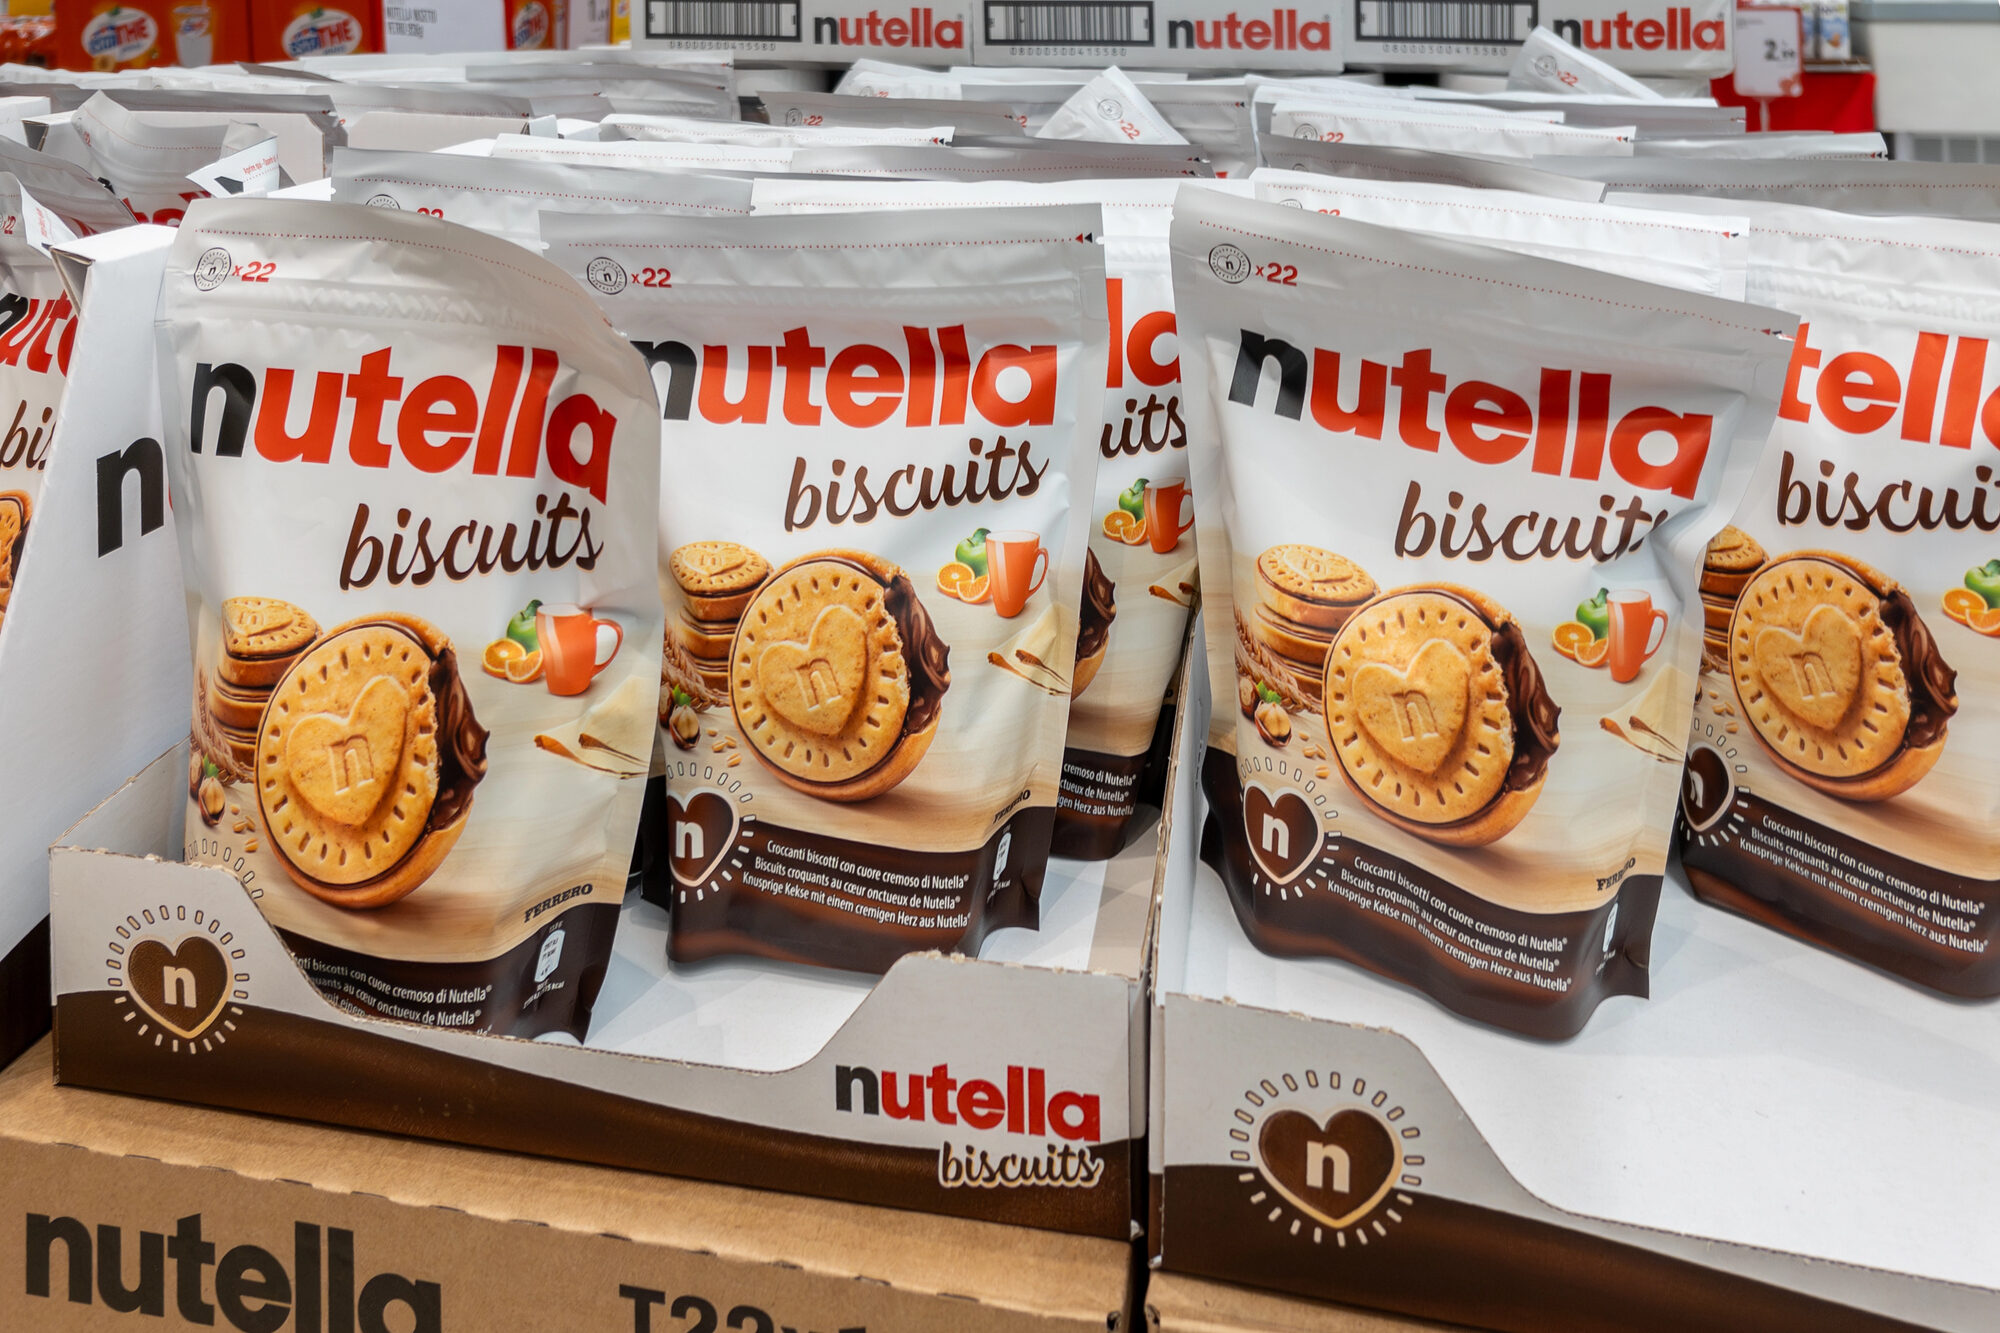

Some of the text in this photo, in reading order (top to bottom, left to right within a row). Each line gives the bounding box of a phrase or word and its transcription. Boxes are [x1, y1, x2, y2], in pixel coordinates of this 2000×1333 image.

[232, 260, 277, 283] x22
[631, 267, 673, 289] x22
[1255, 261, 1298, 287] x22
[630, 323, 1057, 428] nutella
[191, 344, 618, 505] nutella
[1228, 328, 1713, 500] nutella
[784, 435, 1049, 532] biscuits
[340, 492, 605, 592] biscuits
[1085, 785, 1095, 798] de
[1092, 805, 1106, 815] aus
[675, 820, 704, 859] n
[1262, 813, 1289, 860] n
[1762, 815, 1803, 842] Croccanti
[1804, 832, 1838, 859] biscotti
[1839, 852, 1856, 868] con
[1858, 862, 1884, 881] cuore
[1886, 875, 1927, 900] cremoso
[1929, 890, 1939, 904] di
[755, 856, 786, 876] Biscuits
[787, 867, 829, 887] croquants
[830, 877, 842, 890] au
[867, 888, 908, 907] onctueux
[909, 894, 921, 908] de
[767, 840, 806, 860] Croccanti
[807, 848, 839, 869] biscotti
[840, 861, 855, 874] con
[856, 865, 881, 880] cuore
[882, 871, 920, 888] cremoso
[921, 875, 930, 888] di
[1751, 826, 1783, 851] Biscuits
[1785, 845, 1829, 873] croquants
[1831, 865, 1843, 879] au
[1871, 885, 1915, 914] onctueux
[1917, 905, 1930, 920] de
[524, 883, 593, 923] FERRERO
[743, 871, 784, 895] Knusprige
[785, 882, 809, 899] Kekse
[810, 890, 826, 904] mit
[827, 894, 854, 912] einem
[855, 904, 896, 924] cremigen
[897, 910, 918, 927] Herz
[919, 916, 935, 928] aus
[1341, 868, 1375, 893] Biscuits
[1376, 886, 1420, 914] croquants
[1421, 910, 1432, 923] au
[1458, 932, 1503, 959] onctueux
[1504, 948, 1517, 962] de
[1354, 856, 1396, 882] Croccanti
[1397, 872, 1430, 902] biscotti
[1430, 896, 1447, 913] con
[1448, 907, 1474, 928] cuore
[1475, 921, 1516, 944] cremoso
[1517, 933, 1528, 947] di
[1740, 837, 1783, 865] Knusprige
[1785, 858, 1809, 878] Kekse
[1811, 872, 1827, 887] mit
[1828, 880, 1857, 903] einem
[1859, 897, 1903, 925] cremigen
[1905, 915, 1927, 936] Herz
[1929, 929, 1947, 945] aus
[1328, 879, 1371, 909] Knusprige
[1373, 899, 1400, 919] Kekse
[1401, 912, 1416, 928] mit
[1418, 922, 1444, 949] einem
[1444, 942, 1488, 970] cremigen
[1489, 960, 1513, 978] Herz
[1513, 971, 1531, 984] aus
[163, 966, 197, 1008] n
[313, 958, 348, 976] biscotti
[350, 969, 366, 982] con
[368, 976, 391, 995] cuore
[392, 986, 434, 1004] cremoso
[436, 988, 447, 1004] di
[343, 983, 354, 995] au
[377, 1001, 421, 1022] onctueux
[422, 1011, 435, 1025] de
[835, 1063, 1100, 1142] nutella
[939, 1140, 1103, 1187] biscuits
[1306, 1141, 1350, 1194] n
[26, 1213, 441, 1333] nutella
